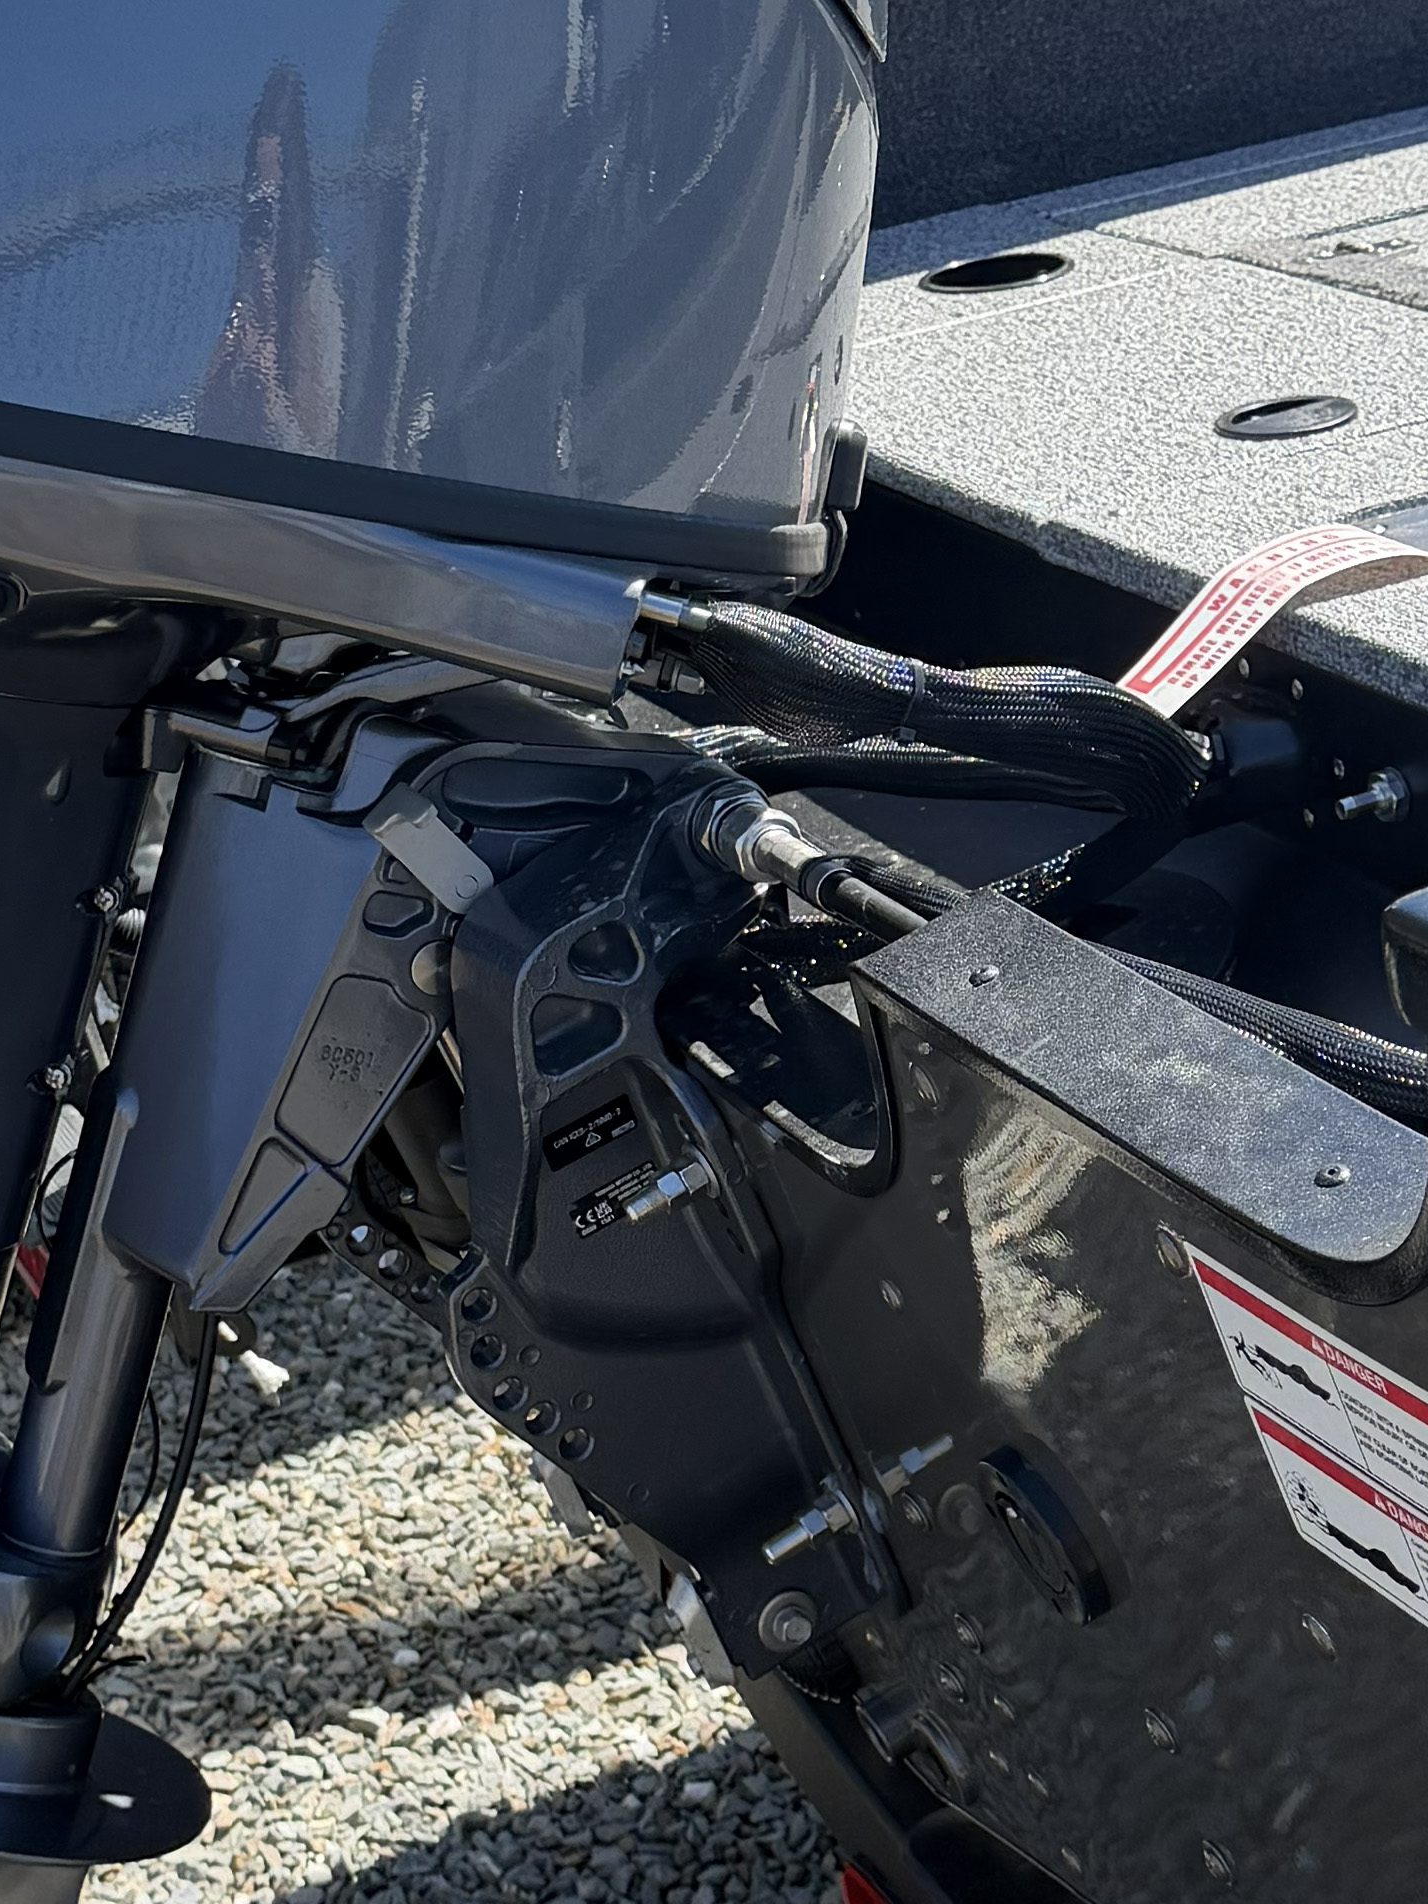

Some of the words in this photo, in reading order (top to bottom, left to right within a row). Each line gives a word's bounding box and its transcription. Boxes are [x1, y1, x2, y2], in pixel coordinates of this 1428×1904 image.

[1201, 639, 1236, 670] WITH
[1233, 609, 1264, 637] SEAT
[1215, 609, 1243, 635] MAY
[1323, 1342, 1389, 1395] DANGER
